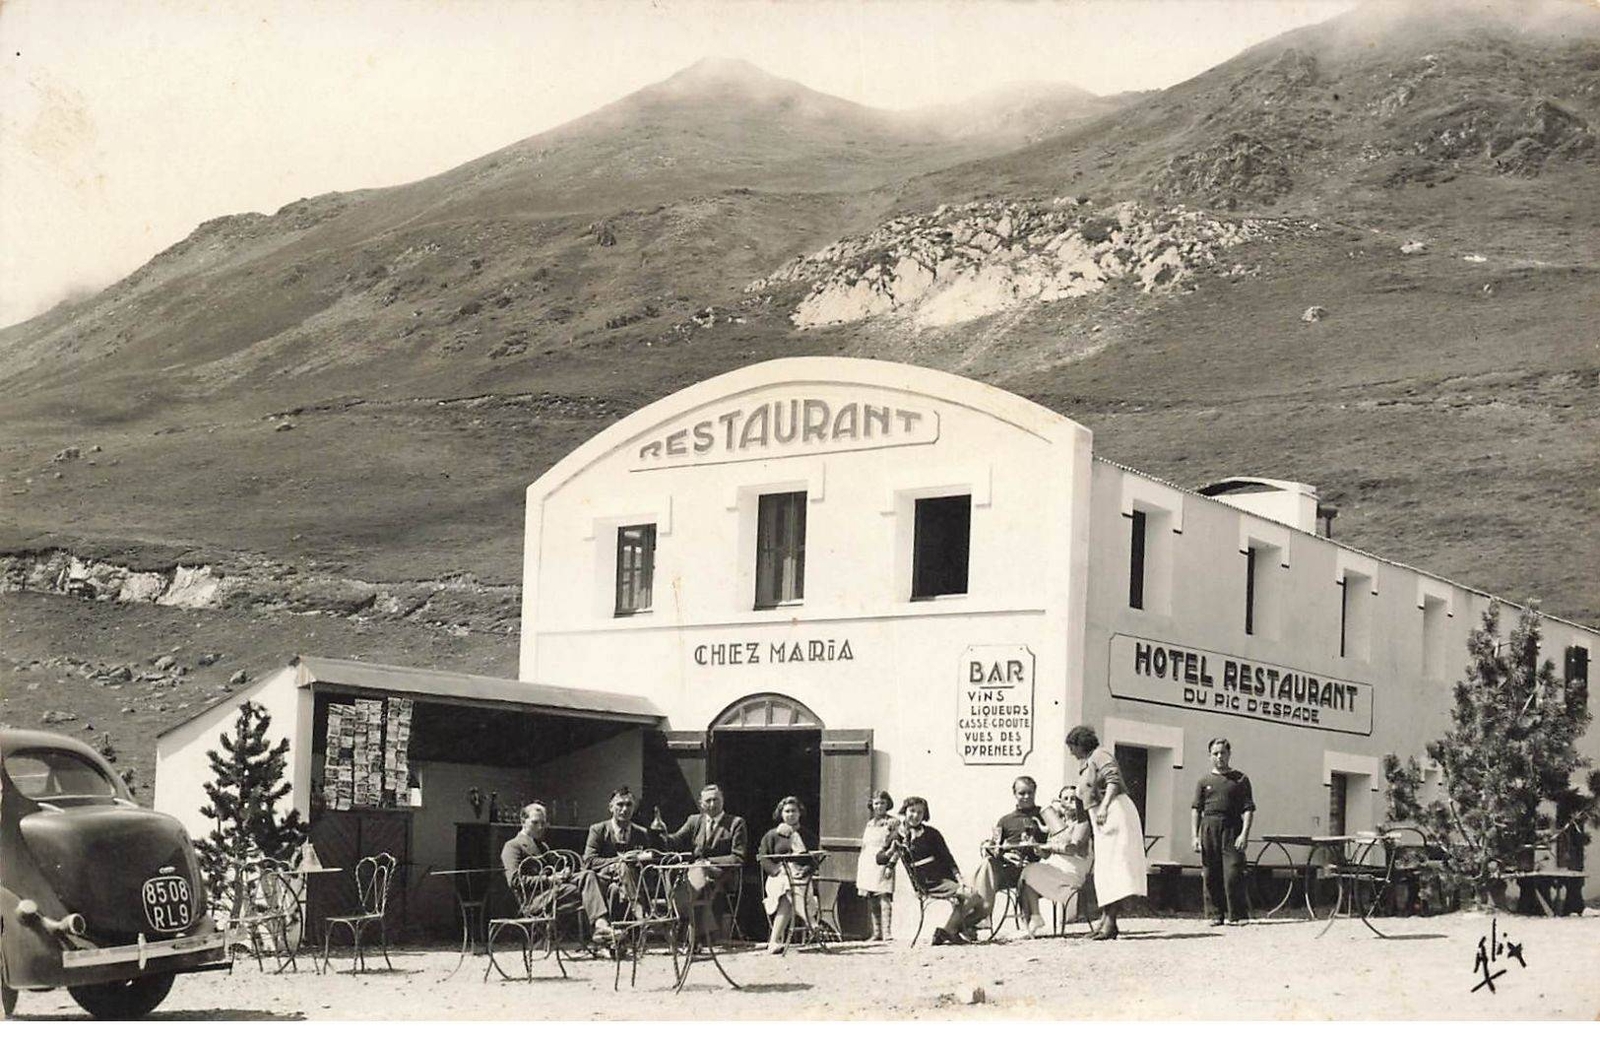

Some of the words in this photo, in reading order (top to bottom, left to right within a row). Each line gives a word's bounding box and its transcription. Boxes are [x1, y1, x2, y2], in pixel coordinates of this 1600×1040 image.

[639, 399, 922, 459] RESTAURANT
[694, 642, 760, 666] CHEZ
[969, 660, 1024, 684] BAR
[1134, 642, 1213, 687] HOTEL
[1223, 659, 1358, 712] RESTAURANT
[1183, 688, 1207, 704] DU
[1247, 700, 1320, 724] D'ESPADE
[965, 731, 993, 742] VUES
[1000, 731, 1022, 742] DES
[964, 745, 1022, 757] PYRENEES
[146, 881, 188, 904] 8508
[154, 904, 189, 929] RL9
